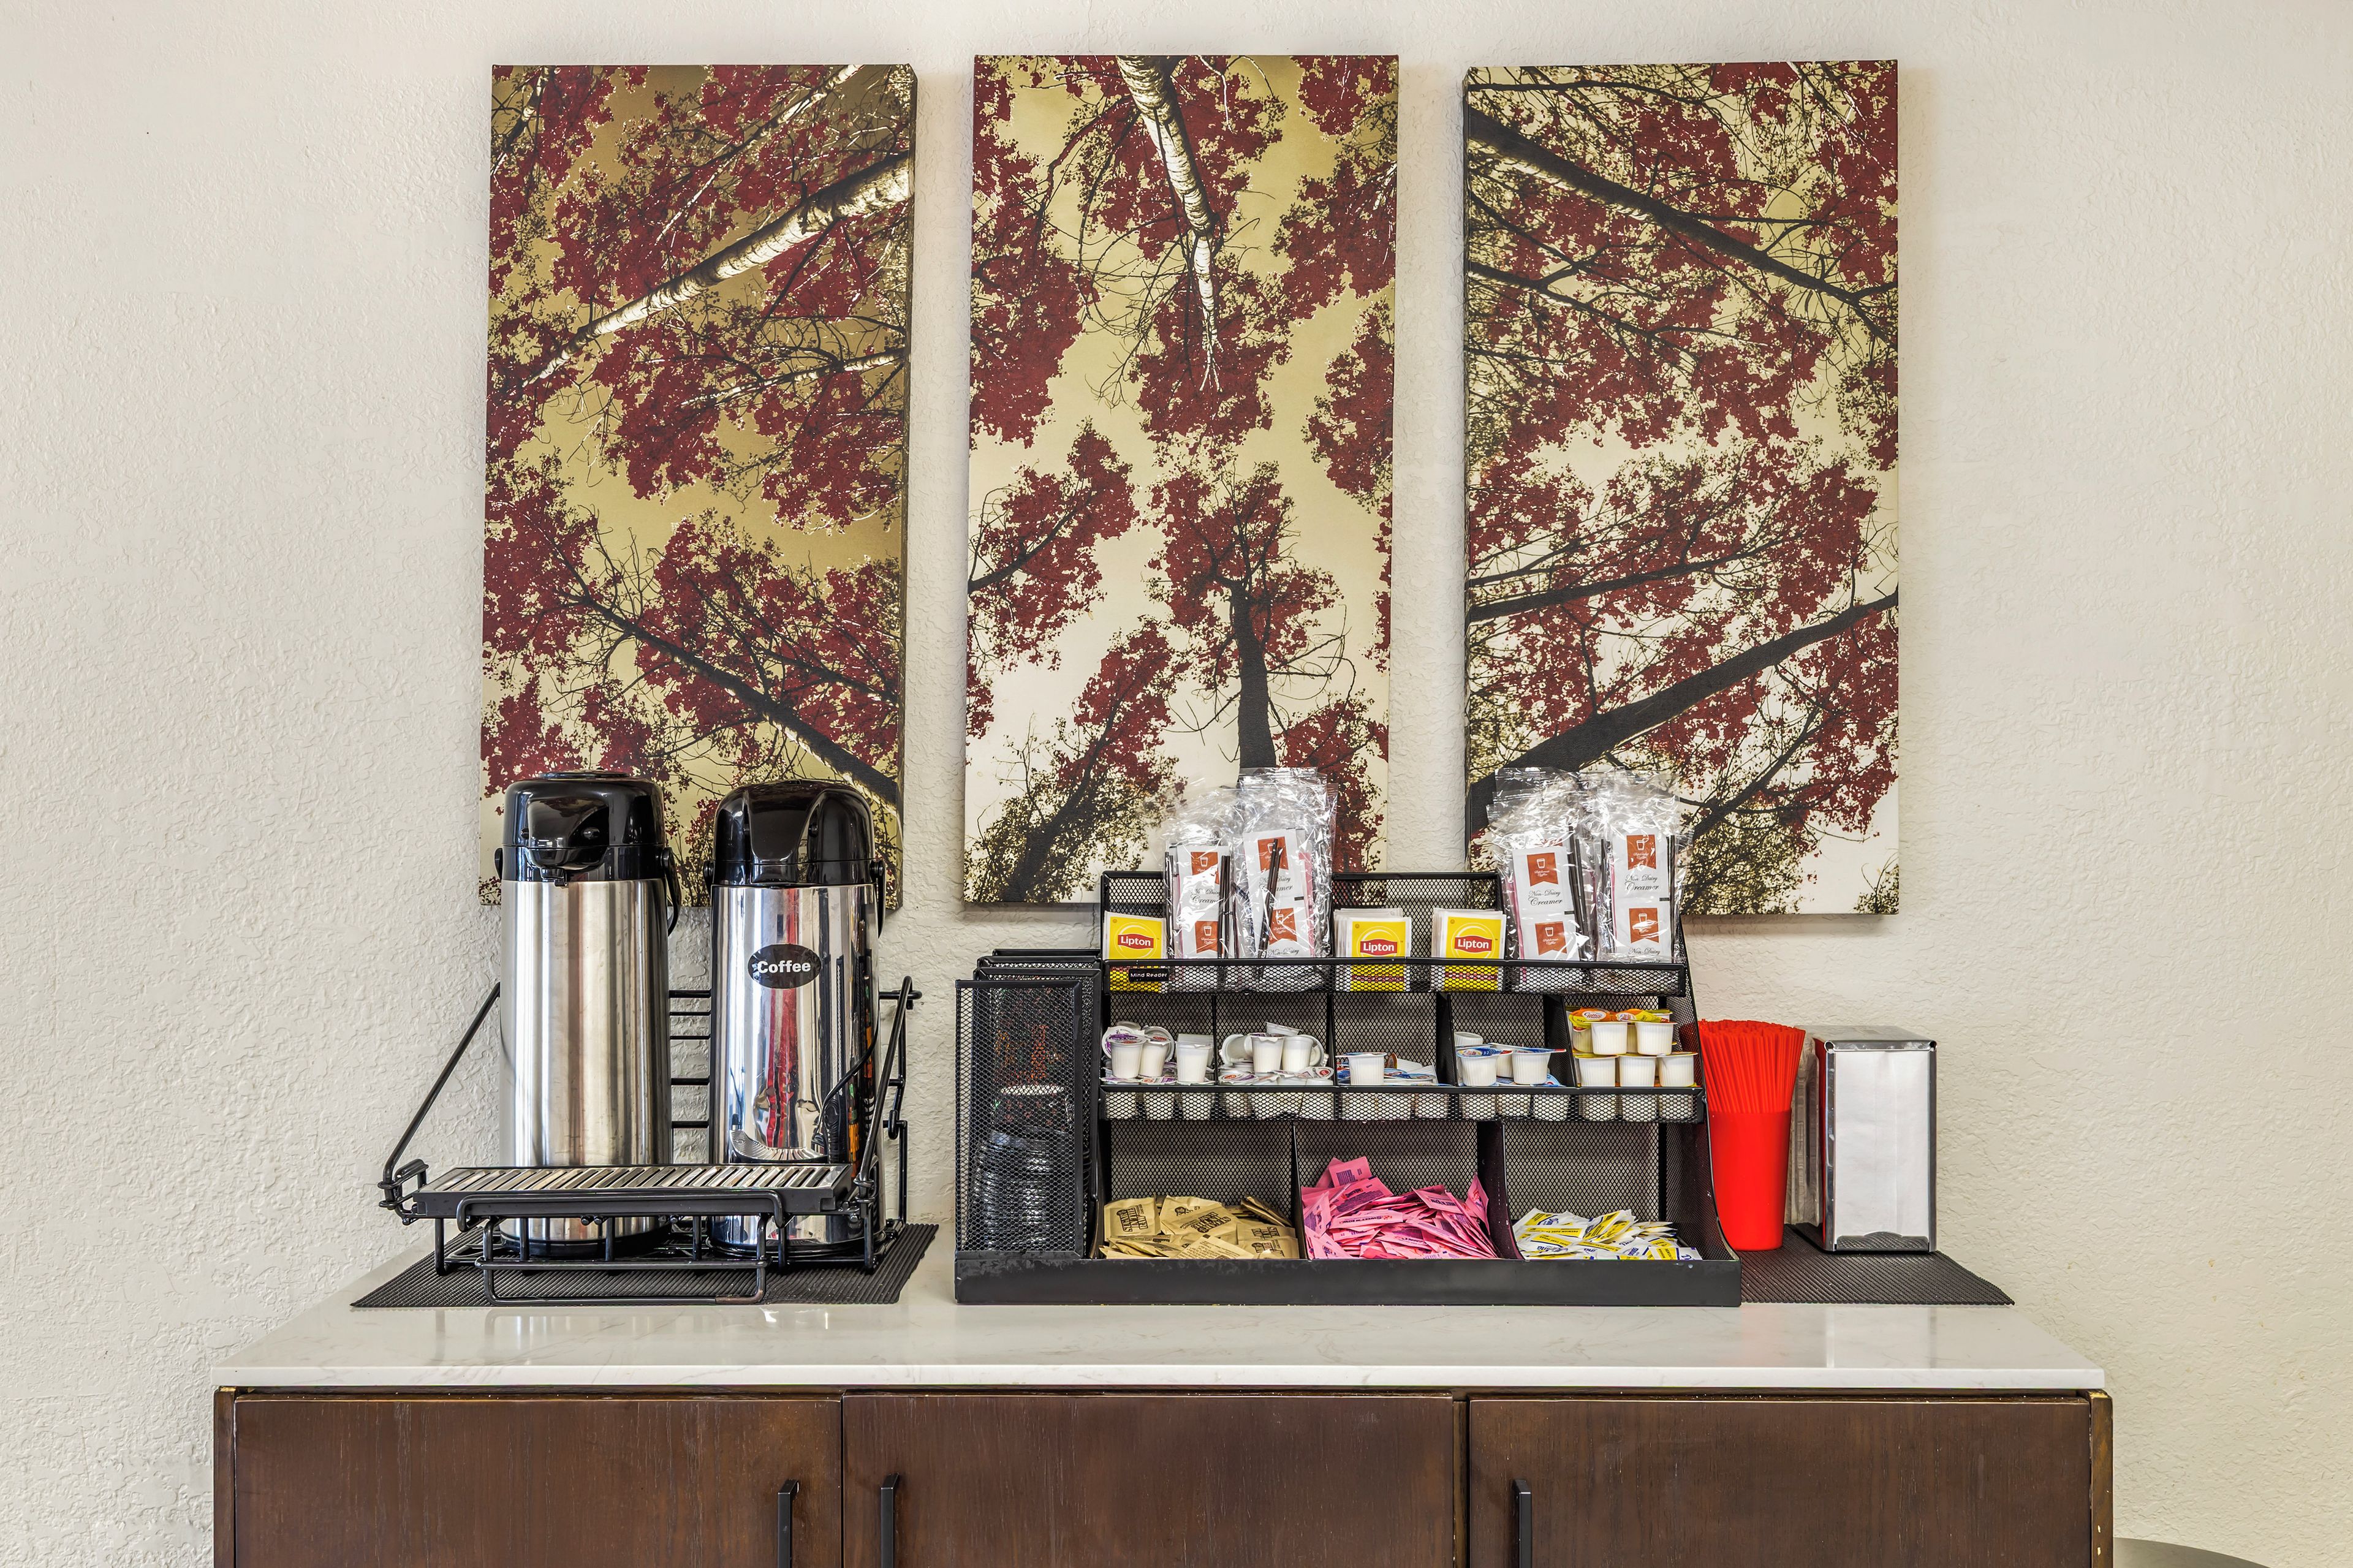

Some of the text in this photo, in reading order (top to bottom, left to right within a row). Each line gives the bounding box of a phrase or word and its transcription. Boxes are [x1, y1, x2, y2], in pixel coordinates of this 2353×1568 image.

[1625, 874, 1658, 883] NonDairy
[1624, 881, 1659, 892] Creamer
[1528, 888, 1561, 897] Non-Dairy
[1528, 894, 1563, 906] Creamer
[1121, 936, 1151, 947] Lipton
[1363, 942, 1395, 952] Lipton
[1457, 938, 1490, 949] Lipton
[757, 960, 811, 974] Coffee
[1120, 1212, 1132, 1232] SUGAR
